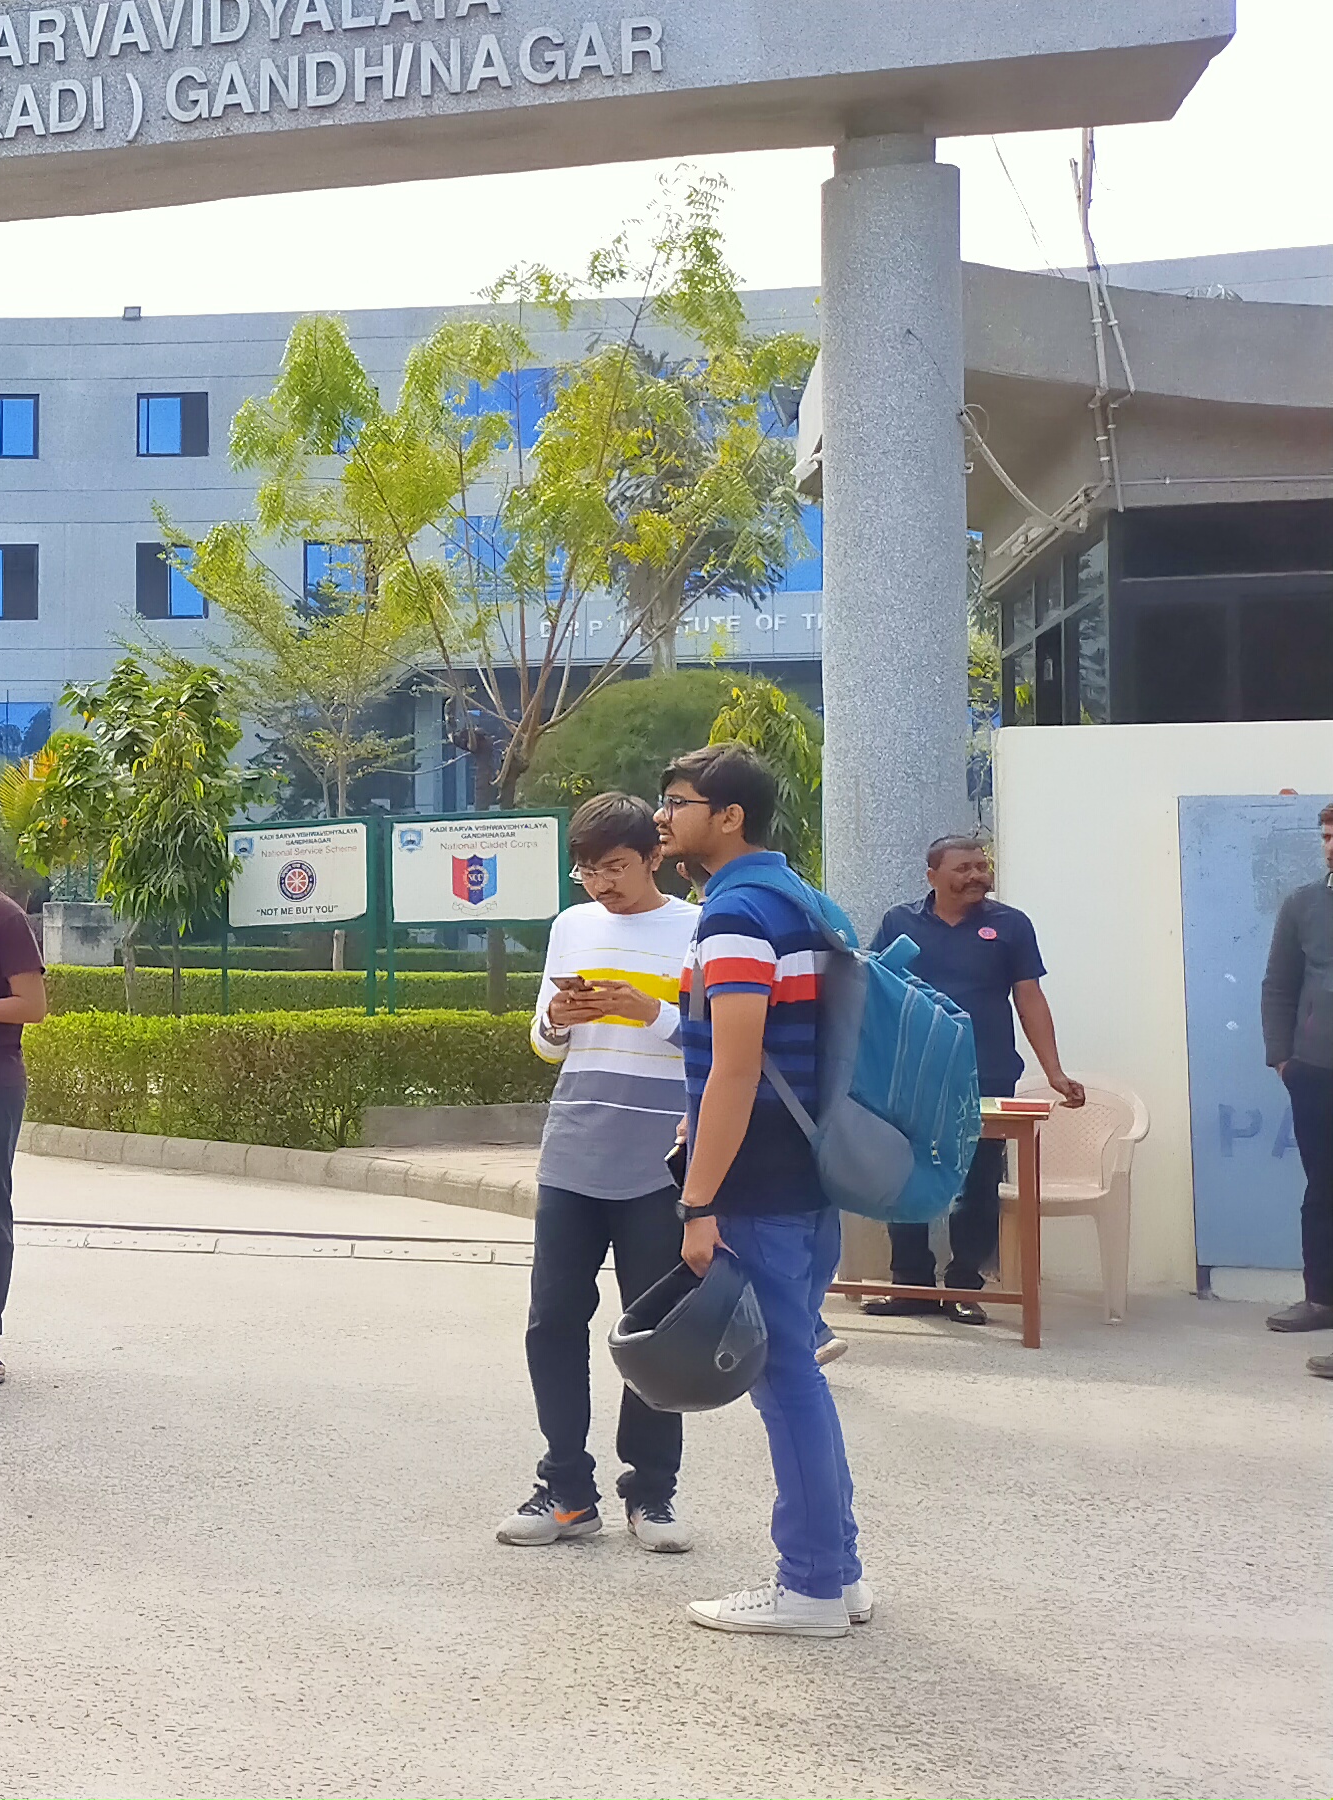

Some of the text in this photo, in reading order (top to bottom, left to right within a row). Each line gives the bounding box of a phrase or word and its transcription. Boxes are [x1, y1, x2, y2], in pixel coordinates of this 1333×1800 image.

[755, 613, 787, 632] OF
[440, 841, 478, 850] National
[280, 906, 294, 915] ME
[295, 906, 314, 915] BUT
